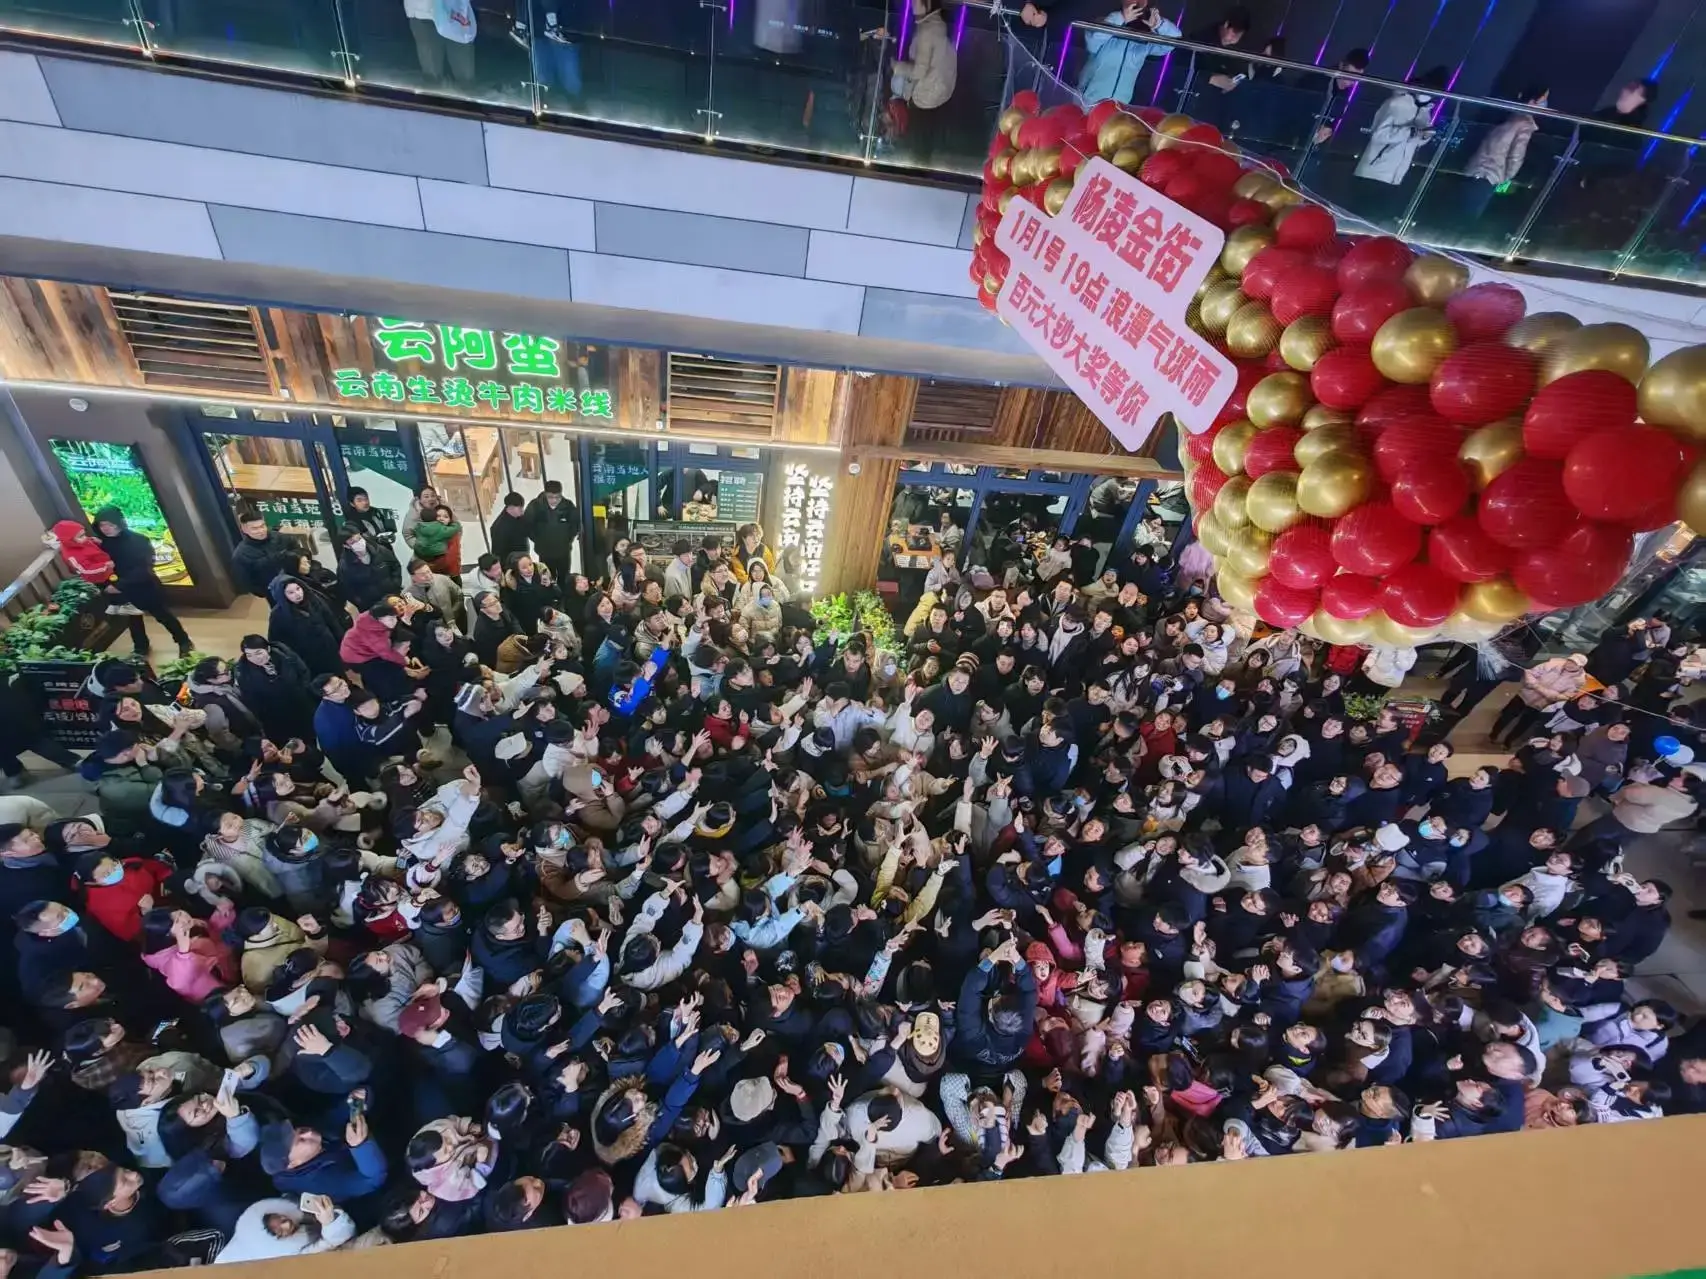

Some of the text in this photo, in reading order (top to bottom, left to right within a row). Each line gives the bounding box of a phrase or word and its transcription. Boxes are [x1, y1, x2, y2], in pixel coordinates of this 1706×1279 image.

[1008, 272, 1149, 426] 百元大钞大奖等你
[1009, 210, 1221, 407] 1月1号 19点 浪漫气球雨
[333, 369, 613, 418] 云南生烫牛肉米线
